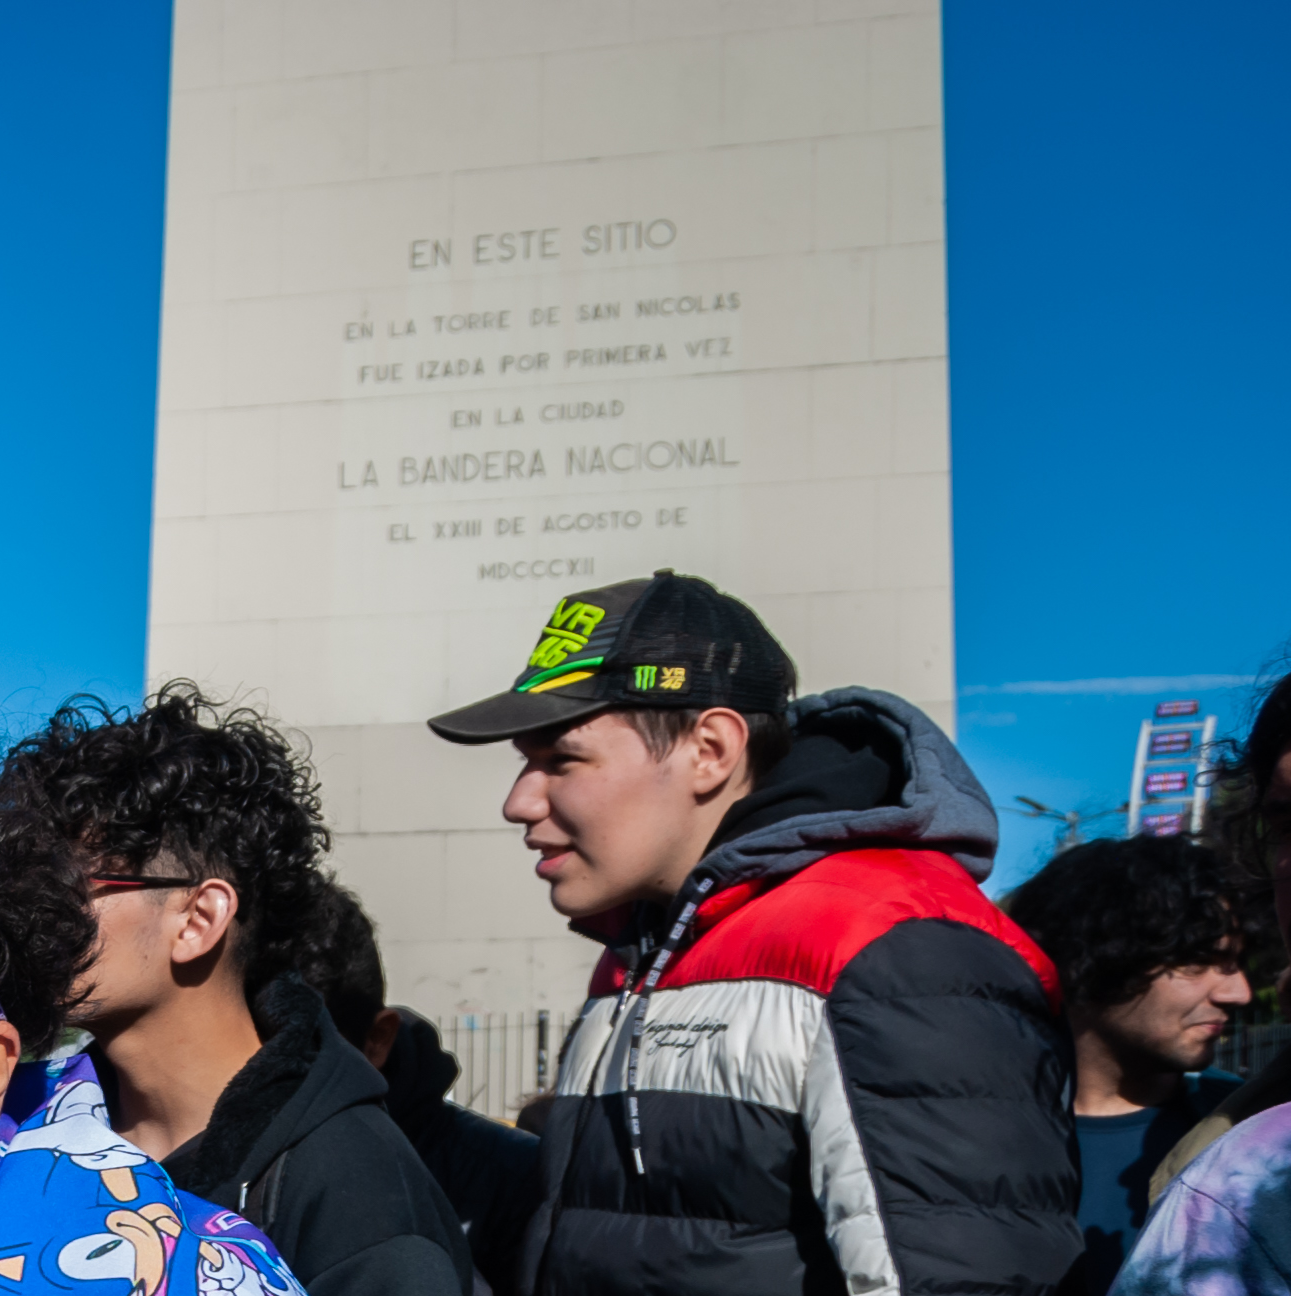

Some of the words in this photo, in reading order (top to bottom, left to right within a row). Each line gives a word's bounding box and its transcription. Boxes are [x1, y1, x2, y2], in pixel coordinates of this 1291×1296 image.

[409, 238, 452, 270] EN
[473, 227, 561, 265] ESTE
[581, 218, 677, 256] SITIO
[344, 320, 373, 342] EN
[388, 318, 417, 339] LA
[434, 309, 512, 334] TORRE
[531, 304, 561, 327] DE
[577, 301, 621, 323] SAN
[635, 291, 741, 319] NICOLAS
[359, 362, 403, 385] FUE
[418, 355, 485, 382] IZADA
[500, 350, 550, 375] POR
[565, 342, 668, 368] PRIMERA
[685, 335, 733, 358] VEZ
[451, 408, 482, 429] EN
[495, 405, 525, 427] LA
[539, 399, 625, 424] CIUDAD
[338, 459, 379, 491] LA
[399, 448, 547, 487] BANDERA
[565, 436, 741, 476] NACIONAL
[387, 522, 417, 543] EL
[434, 518, 483, 540] XXIII
[495, 515, 526, 537] DE
[542, 509, 643, 533] AGOSTO
[656, 506, 688, 528] DE
[479, 556, 595, 581] MDCCCXII
[551, 598, 606, 636] VR
[528, 636, 583, 669] 46
[659, 678, 686, 690] 46
